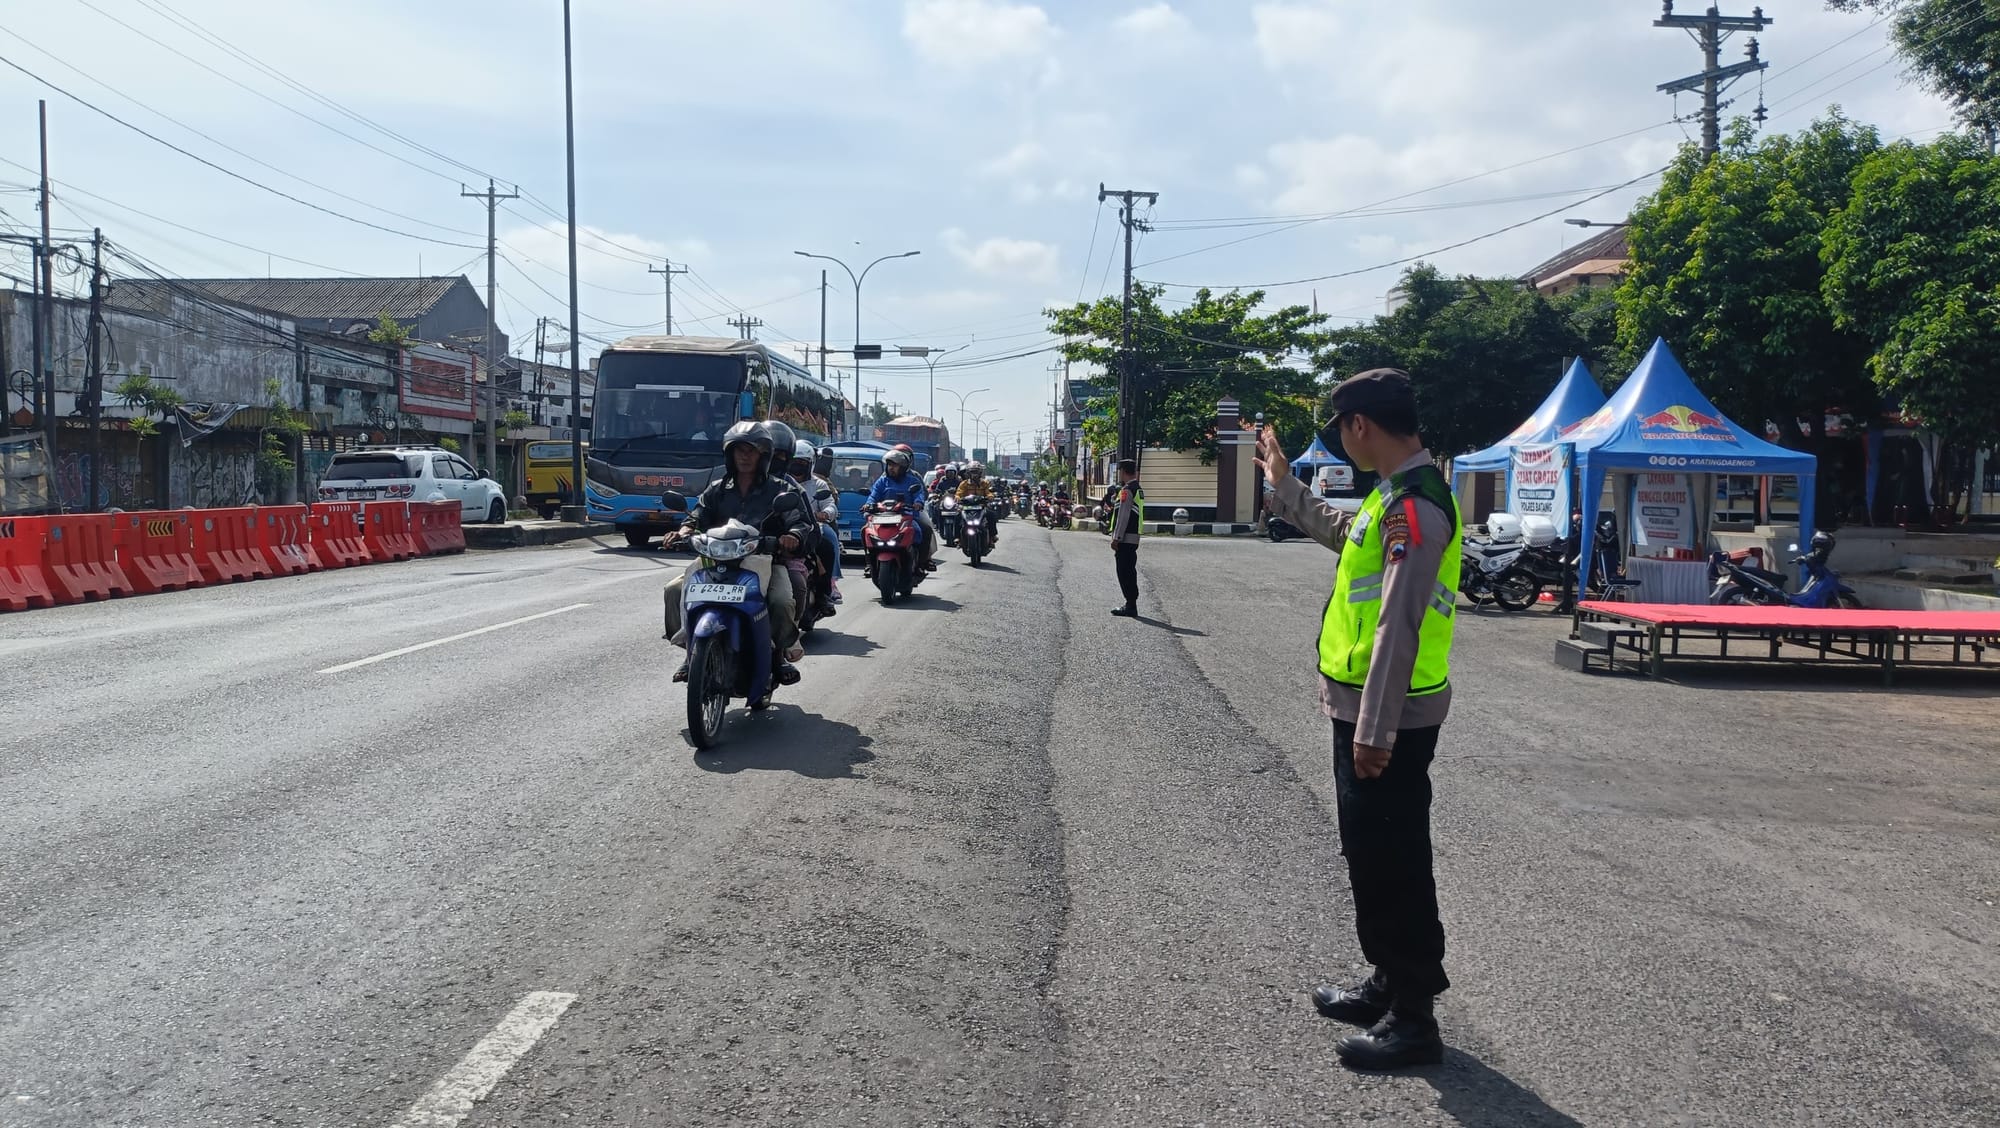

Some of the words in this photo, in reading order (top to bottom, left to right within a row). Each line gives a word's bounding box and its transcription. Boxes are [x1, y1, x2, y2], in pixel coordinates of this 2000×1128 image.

[1689, 458, 1756, 467] KRATINGDAENGID
[634, 475, 684, 487] COYO
[1520, 502, 1535, 512] POLRES
[1536, 502, 1553, 513] BATANG
[689, 585, 696, 593] G
[700, 585, 725, 594] 6249
[731, 586, 744, 594] RR
